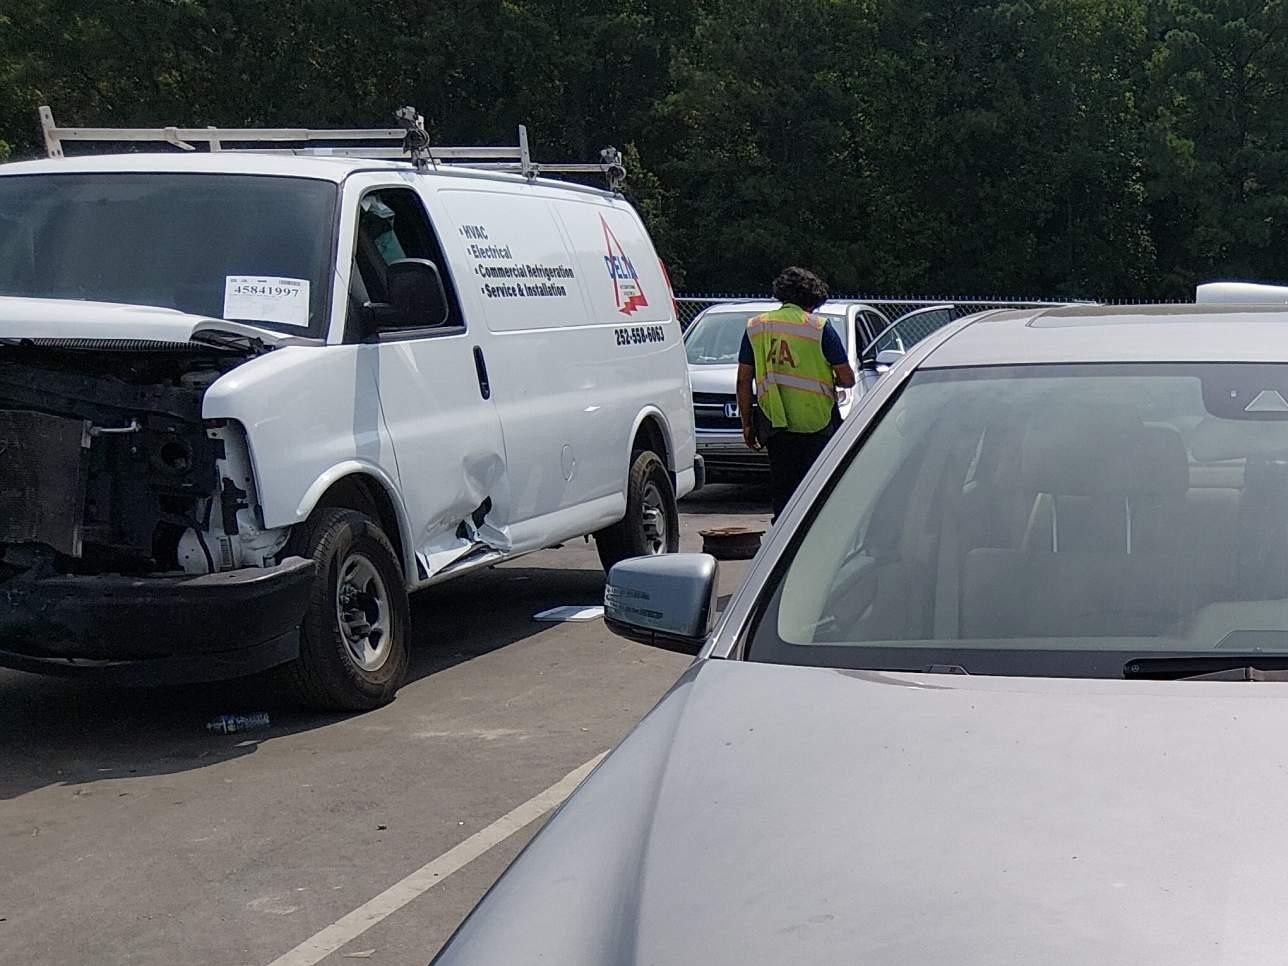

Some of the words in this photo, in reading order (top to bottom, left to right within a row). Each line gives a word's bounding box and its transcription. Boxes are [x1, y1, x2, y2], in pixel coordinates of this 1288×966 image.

[463, 225, 488, 240] HVAC
[471, 244, 512, 259] Electrical
[478, 263, 528, 279] Commercial
[526, 264, 574, 281] Refrigeration
[234, 286, 299, 297] 45841997
[484, 283, 517, 298] Service
[517, 282, 526, 297] &
[524, 283, 566, 297] Installation
[615, 326, 664, 346] 252-558-6063
